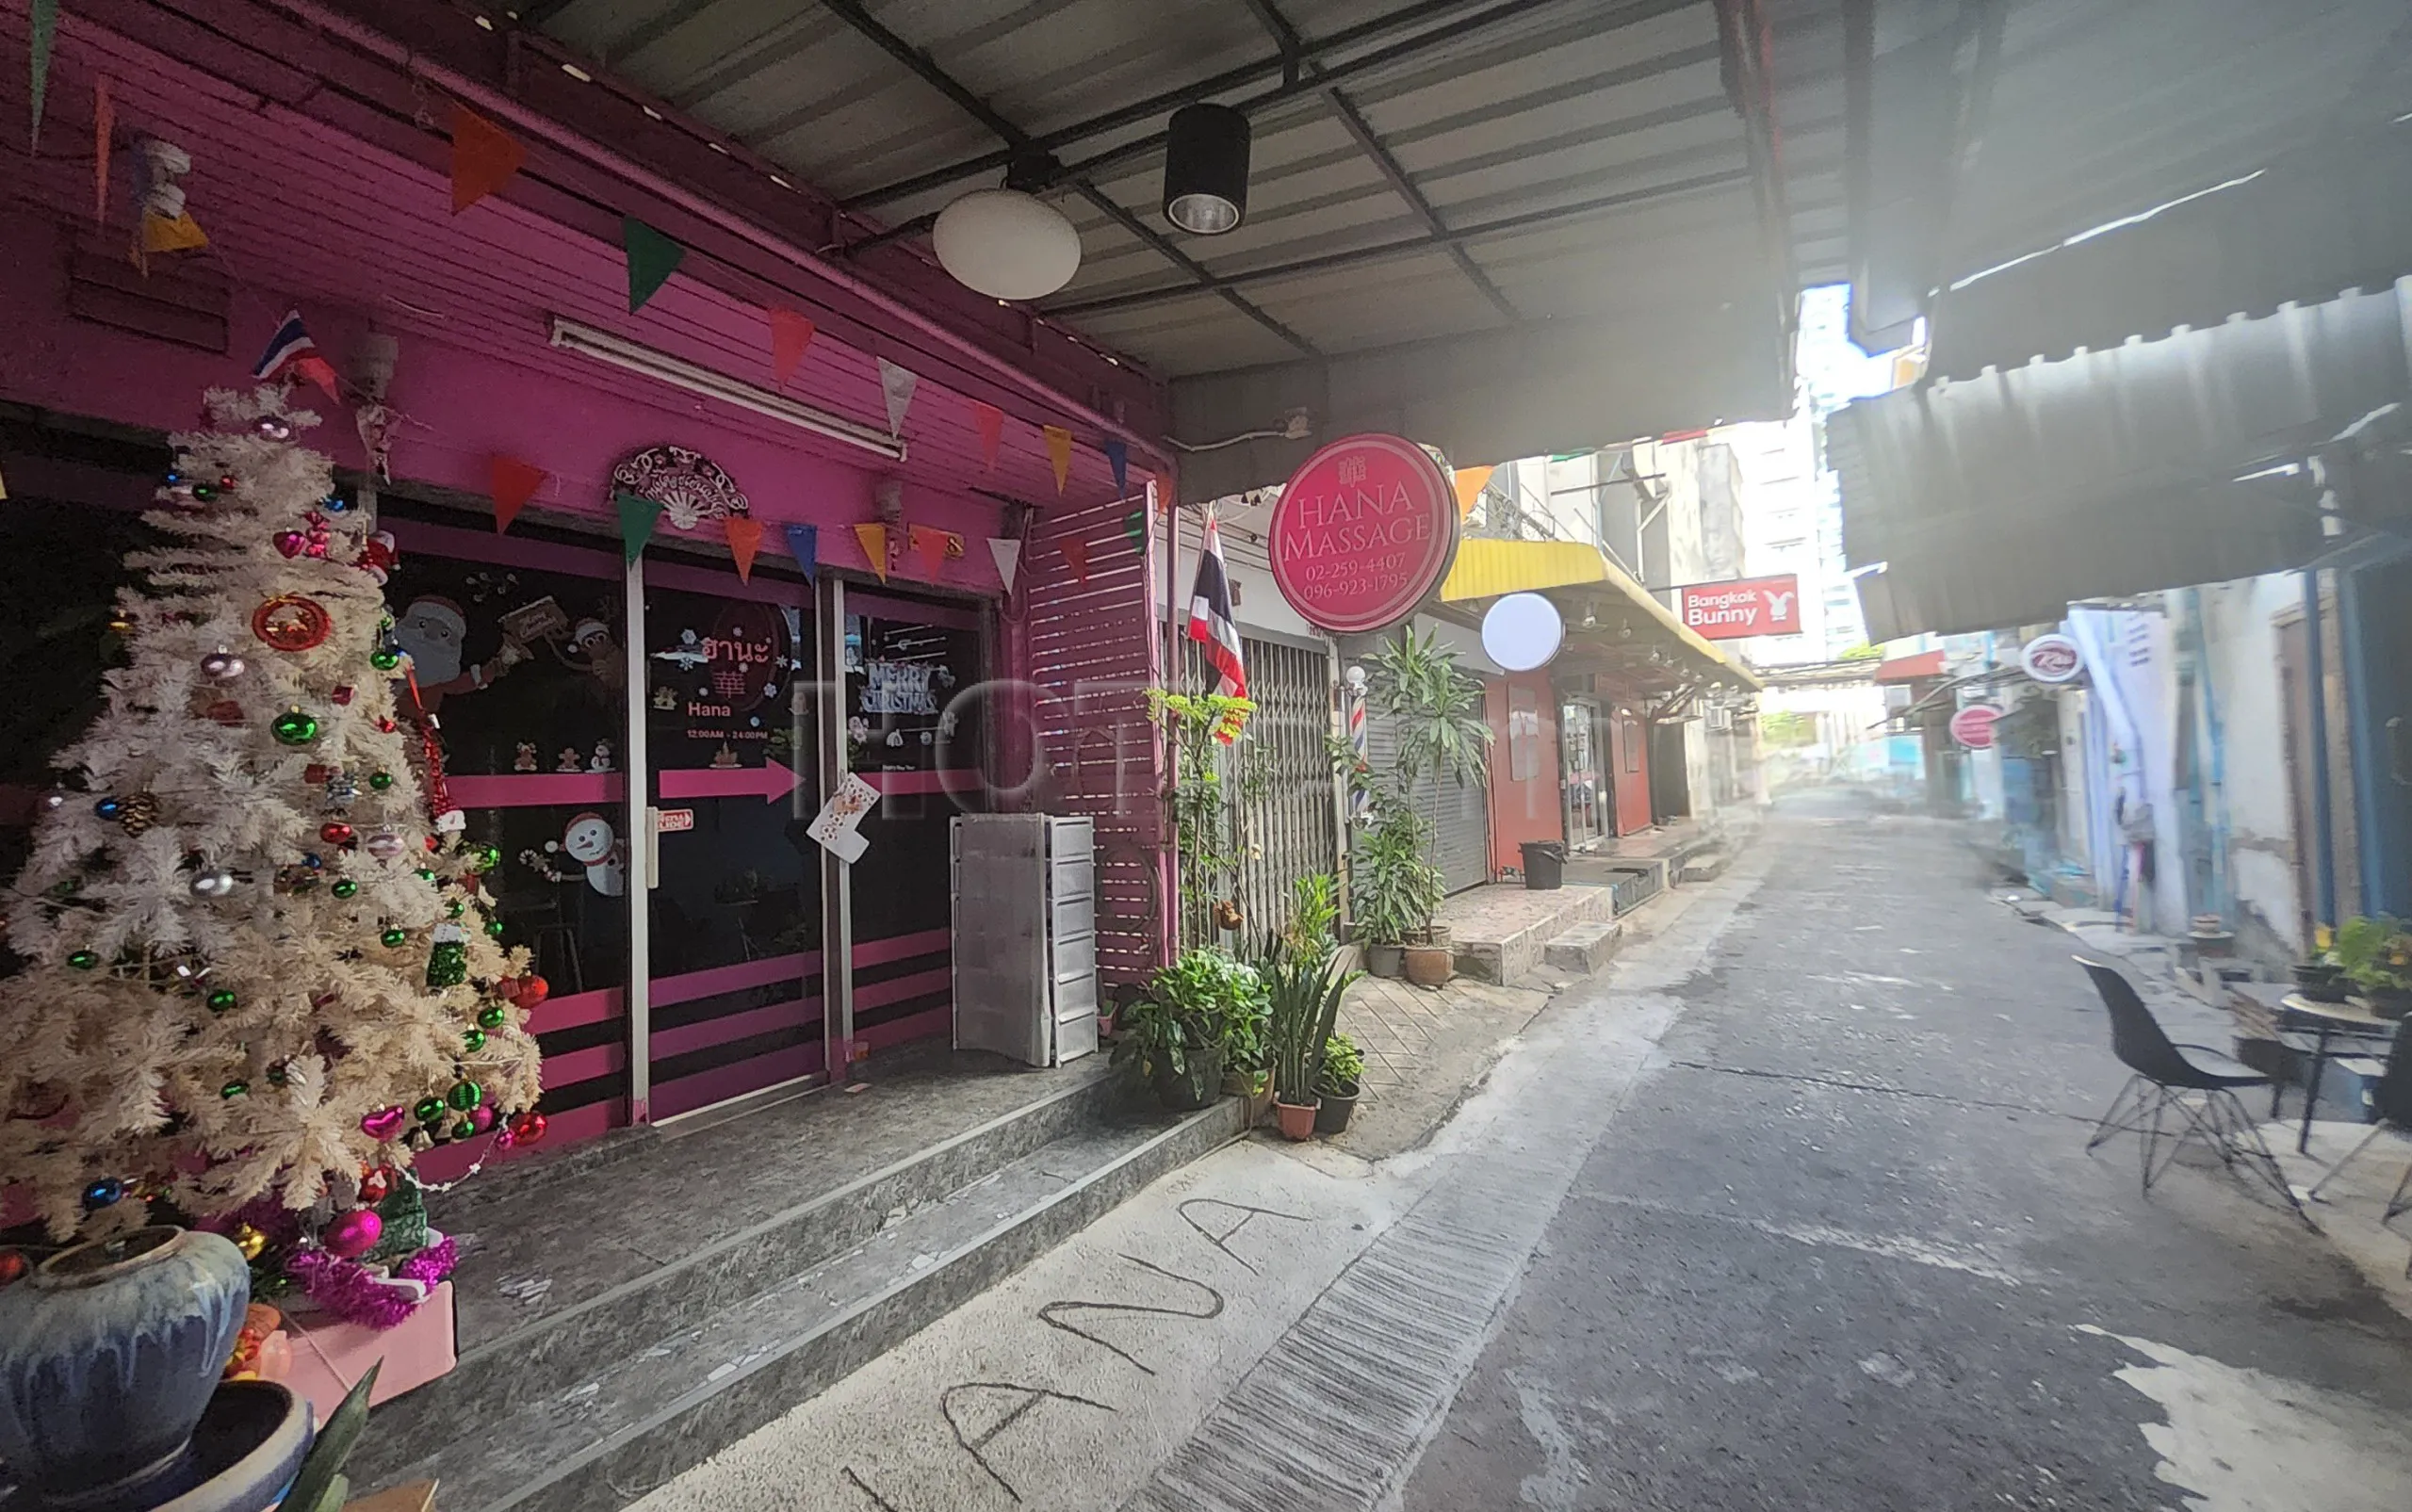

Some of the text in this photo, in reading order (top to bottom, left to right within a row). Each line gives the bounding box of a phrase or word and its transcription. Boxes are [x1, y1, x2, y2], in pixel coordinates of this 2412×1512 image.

[1297, 480, 1415, 530] HANA
[1284, 513, 1431, 561] MASSAGE
[1306, 553, 1406, 581] 02-259-4407
[1304, 573, 1408, 600] 096-923-1795
[1688, 590, 1757, 609] Bangkok
[1688, 608, 1758, 626] Bunny
[700, 637, 769, 663] ฮานะ
[869, 663, 931, 692] MERRY
[687, 702, 731, 717] Hana
[861, 689, 938, 714] CHRISTMAS
[841, 1196, 1312, 1512] ANA
